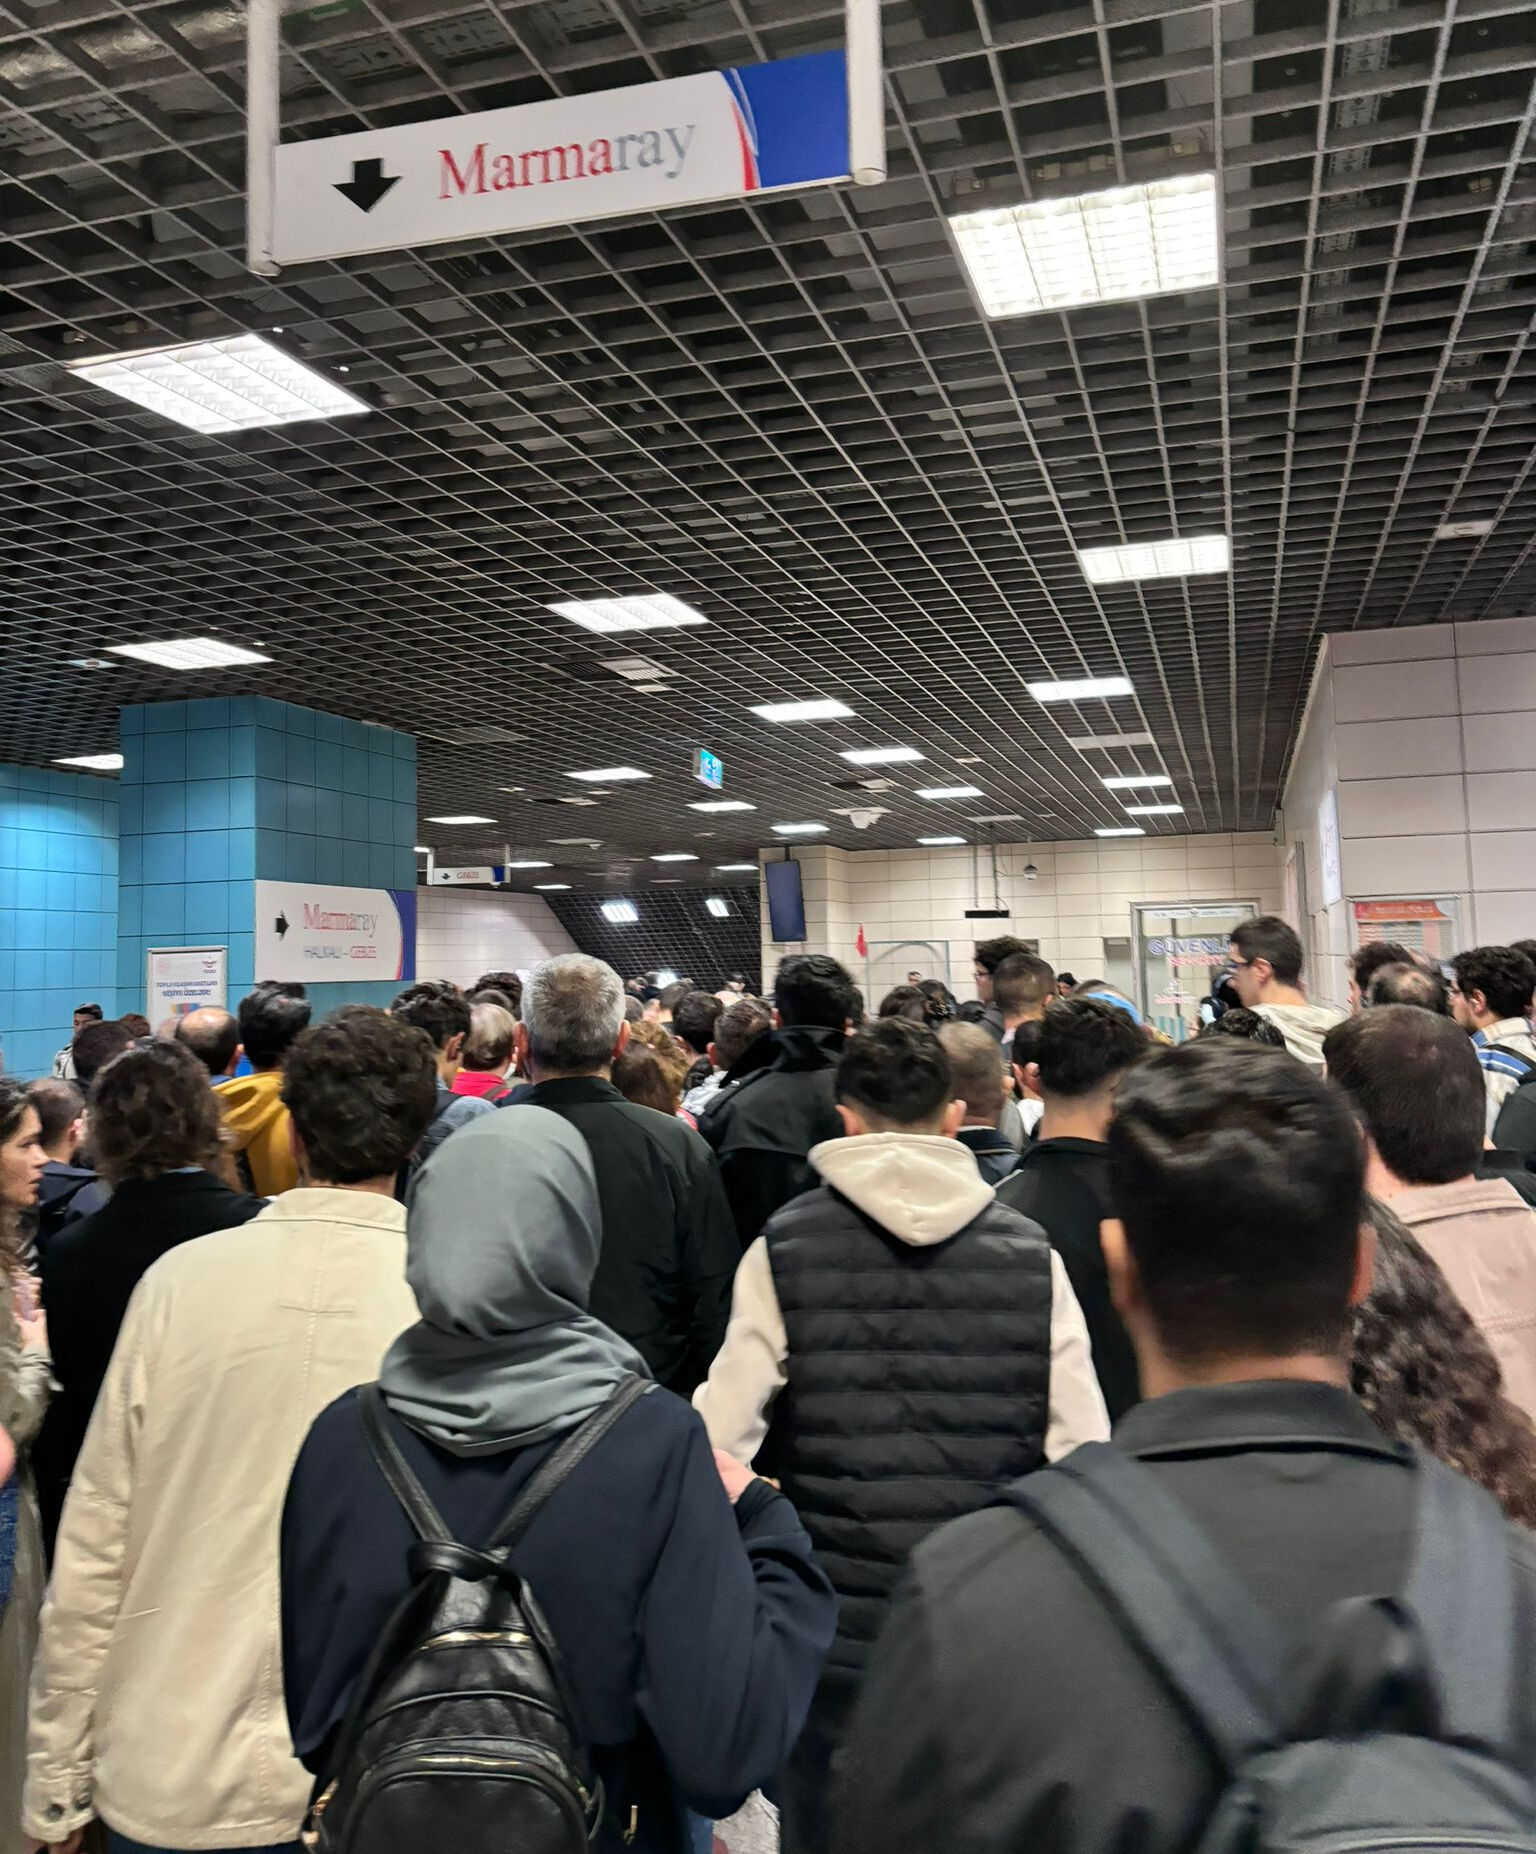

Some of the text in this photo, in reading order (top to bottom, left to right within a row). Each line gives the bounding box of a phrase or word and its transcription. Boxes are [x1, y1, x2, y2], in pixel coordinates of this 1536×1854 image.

[438, 122, 696, 199] Marmaray
[303, 903, 378, 938] Marmaray
[1148, 934, 1231, 955] GÜVENLİ
